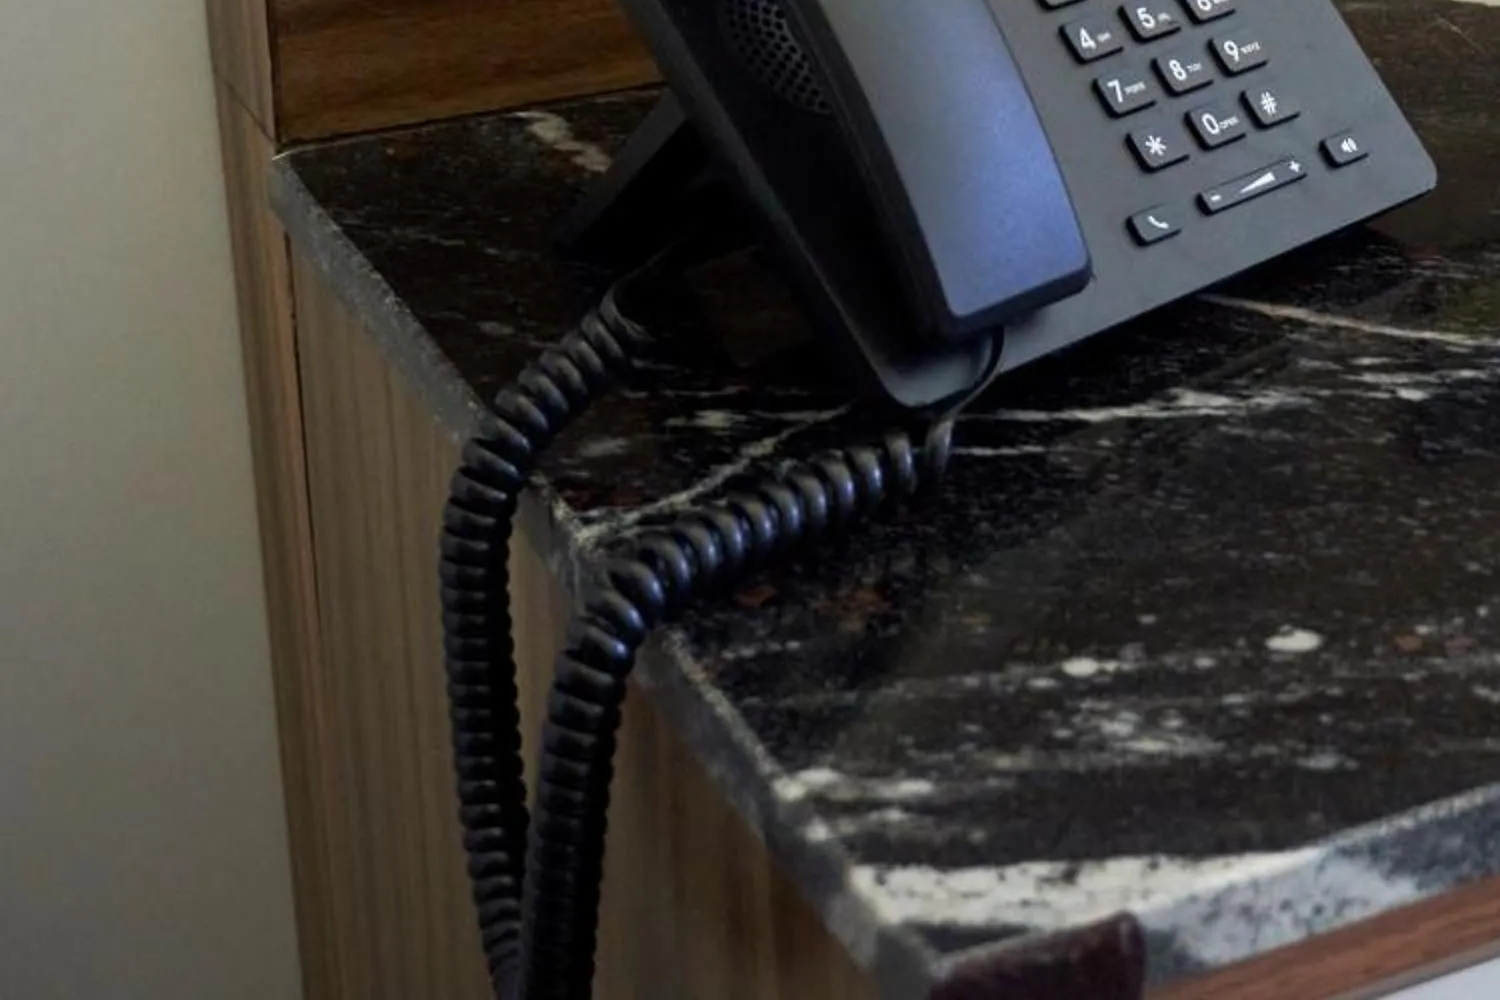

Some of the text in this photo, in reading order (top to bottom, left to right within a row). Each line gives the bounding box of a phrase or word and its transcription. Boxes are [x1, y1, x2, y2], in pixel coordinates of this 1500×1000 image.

[1136, 7, 1156, 29] 5
[1079, 26, 1097, 49] 4
[1223, 40, 1240, 63] 9
[1168, 59, 1187, 81] 8
[1106, 78, 1124, 103] 7
[1201, 112, 1220, 135] 0
